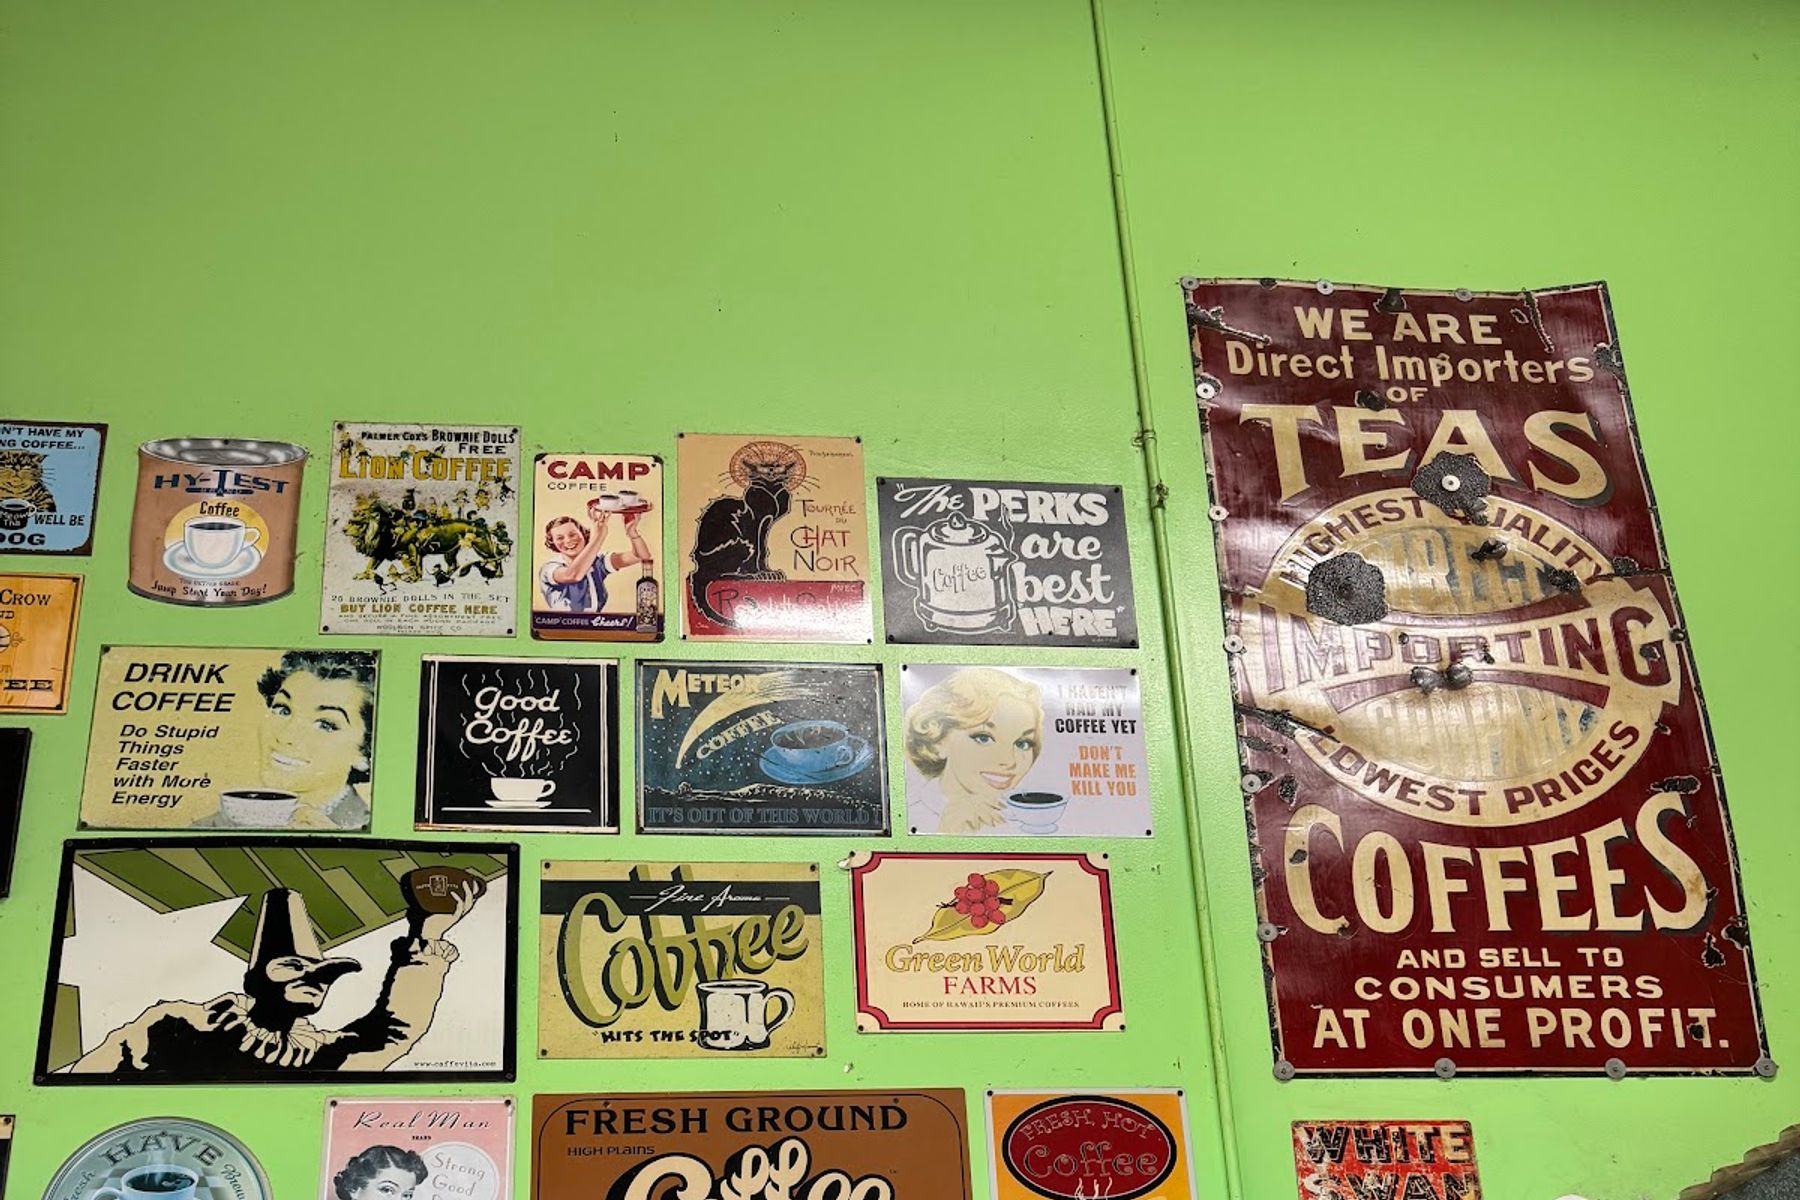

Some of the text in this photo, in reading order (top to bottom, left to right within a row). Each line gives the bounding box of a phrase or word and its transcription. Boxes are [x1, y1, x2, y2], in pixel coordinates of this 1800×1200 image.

[1294, 305, 1503, 346] WE ARE
[1225, 340, 1595, 388] Direct Importers
[1385, 386, 1429, 403] OF
[28, 427, 85, 438] HAVE MY
[361, 431, 400, 441] PALMER
[431, 429, 480, 443] BROWNIE
[483, 430, 516, 444] DOLLS
[458, 443, 507, 455] FREE
[1238, 402, 1609, 505] TEAS
[411, 449, 513, 481] COFFEE
[547, 460, 650, 481] CAMP
[154, 469, 290, 498] HY-TEST
[547, 482, 608, 492] COFFEE
[200, 501, 240, 517] Coffee
[972, 486, 1109, 526] PERKS
[34, 514, 66, 526] WELL
[69, 515, 85, 526] BE
[790, 525, 850, 556] CHAT
[1019, 531, 1104, 561] are
[1279, 496, 1426, 586] HIGHEST
[1474, 503, 1605, 586] UALITY
[793, 549, 860, 577] NOIR
[151, 580, 177, 597] Jump
[241, 583, 268, 598] Day!
[931, 563, 988, 593] Coffee
[1013, 562, 1117, 604] best
[340, 603, 366, 614] BUY
[408, 604, 458, 615] COFFEE
[463, 605, 499, 616] HERE
[1257, 602, 1672, 694] IMPORTING
[124, 662, 230, 684] DRINK
[112, 690, 237, 713] COFFEE
[474, 685, 562, 720] Good
[650, 668, 761, 720] METEOR
[119, 724, 220, 741] Do Stupid
[696, 710, 785, 759] COFFEE
[1055, 717, 1137, 734] COFFEE YET
[118, 741, 185, 757] Things
[465, 718, 573, 763] Coffee
[1078, 745, 1123, 761] DON'T
[116, 757, 179, 771] Faster
[1069, 762, 1137, 779] MAKE ME
[1307, 726, 1487, 816] LOWEST
[1502, 719, 1641, 815] PRICES
[113, 774, 212, 788] with More
[1071, 780, 1137, 796] KILL YOU
[111, 791, 184, 808] Energy
[648, 807, 870, 825] IT'S OUT OF THIS WORLD
[1284, 792, 1711, 936] COFFEES
[644, 884, 762, 913] Fine Aroma
[885, 943, 1086, 974] Green World
[1396, 946, 1623, 969] AND SELL TO
[943, 976, 1038, 995] FARMS
[1354, 975, 1664, 1001] CONSUMERS
[649, 1030, 686, 1043] THE
[1312, 1006, 1730, 1050] AT ONE PROFIT.
[352, 1110, 492, 1130] Real Man
[565, 1104, 908, 1135] FRESH GROUND
[1018, 1108, 1157, 1142] FRESH HOT
[98, 1130, 225, 1168] HAVE
[567, 1146, 603, 1156] HIGH
[1296, 1126, 1472, 1164] WHITE
[430, 1152, 486, 1182] Strong
[1022, 1140, 1159, 1179] Coffee
[432, 1173, 477, 1198] Good
